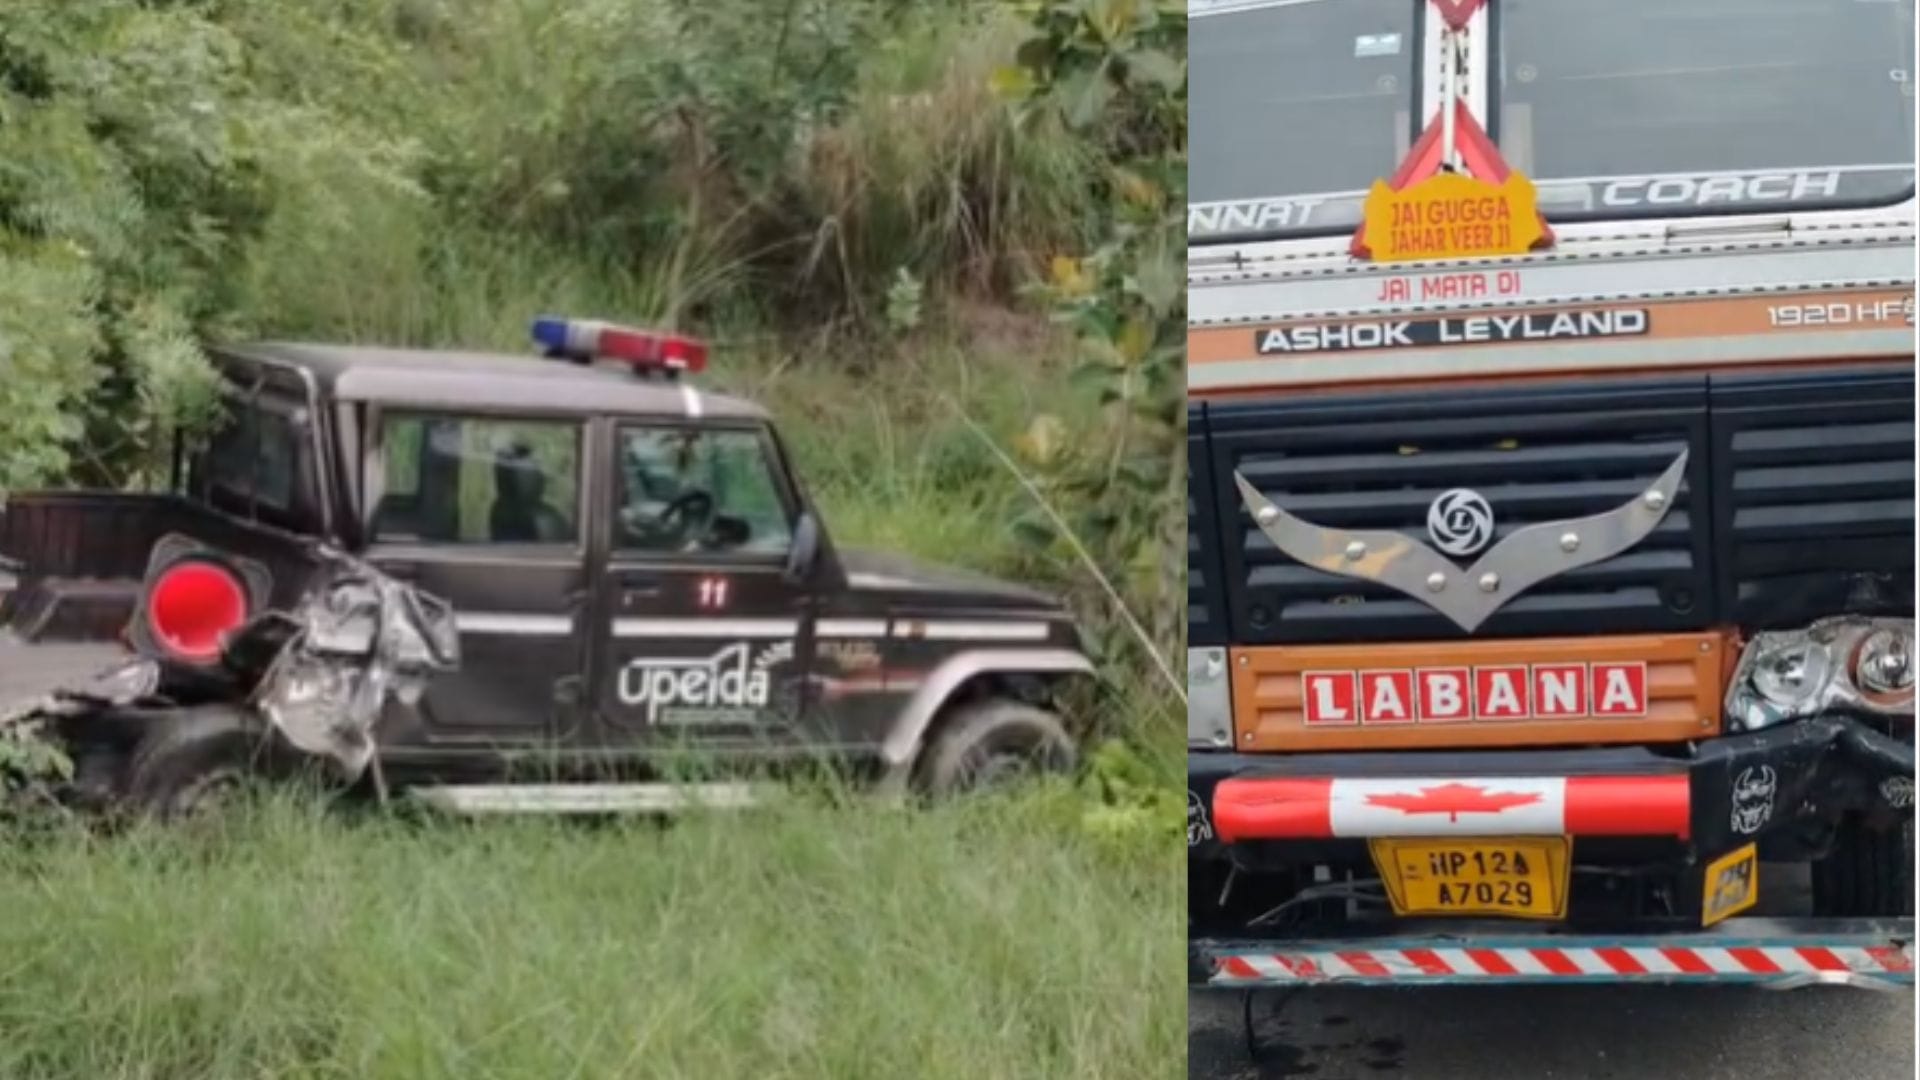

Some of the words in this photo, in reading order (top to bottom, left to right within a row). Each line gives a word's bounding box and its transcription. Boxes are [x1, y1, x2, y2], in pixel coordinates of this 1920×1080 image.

[1603, 172, 1840, 206] COACH
[1390, 202, 1422, 227] JAI
[1427, 197, 1511, 224] GUGGA
[1390, 229, 1446, 254] JAHAR
[1451, 226, 1494, 250] VEER
[1496, 224, 1511, 249] JI
[1378, 277, 1411, 302] JAI
[1421, 273, 1487, 301] MATA
[1498, 271, 1521, 295] DI
[1767, 303, 1851, 325] 1920
[1260, 321, 1413, 353] ASHOK
[1439, 309, 1646, 343] LEYLAND
[1313, 666, 1637, 720] LABANA
[1439, 881, 1533, 906] A7029
